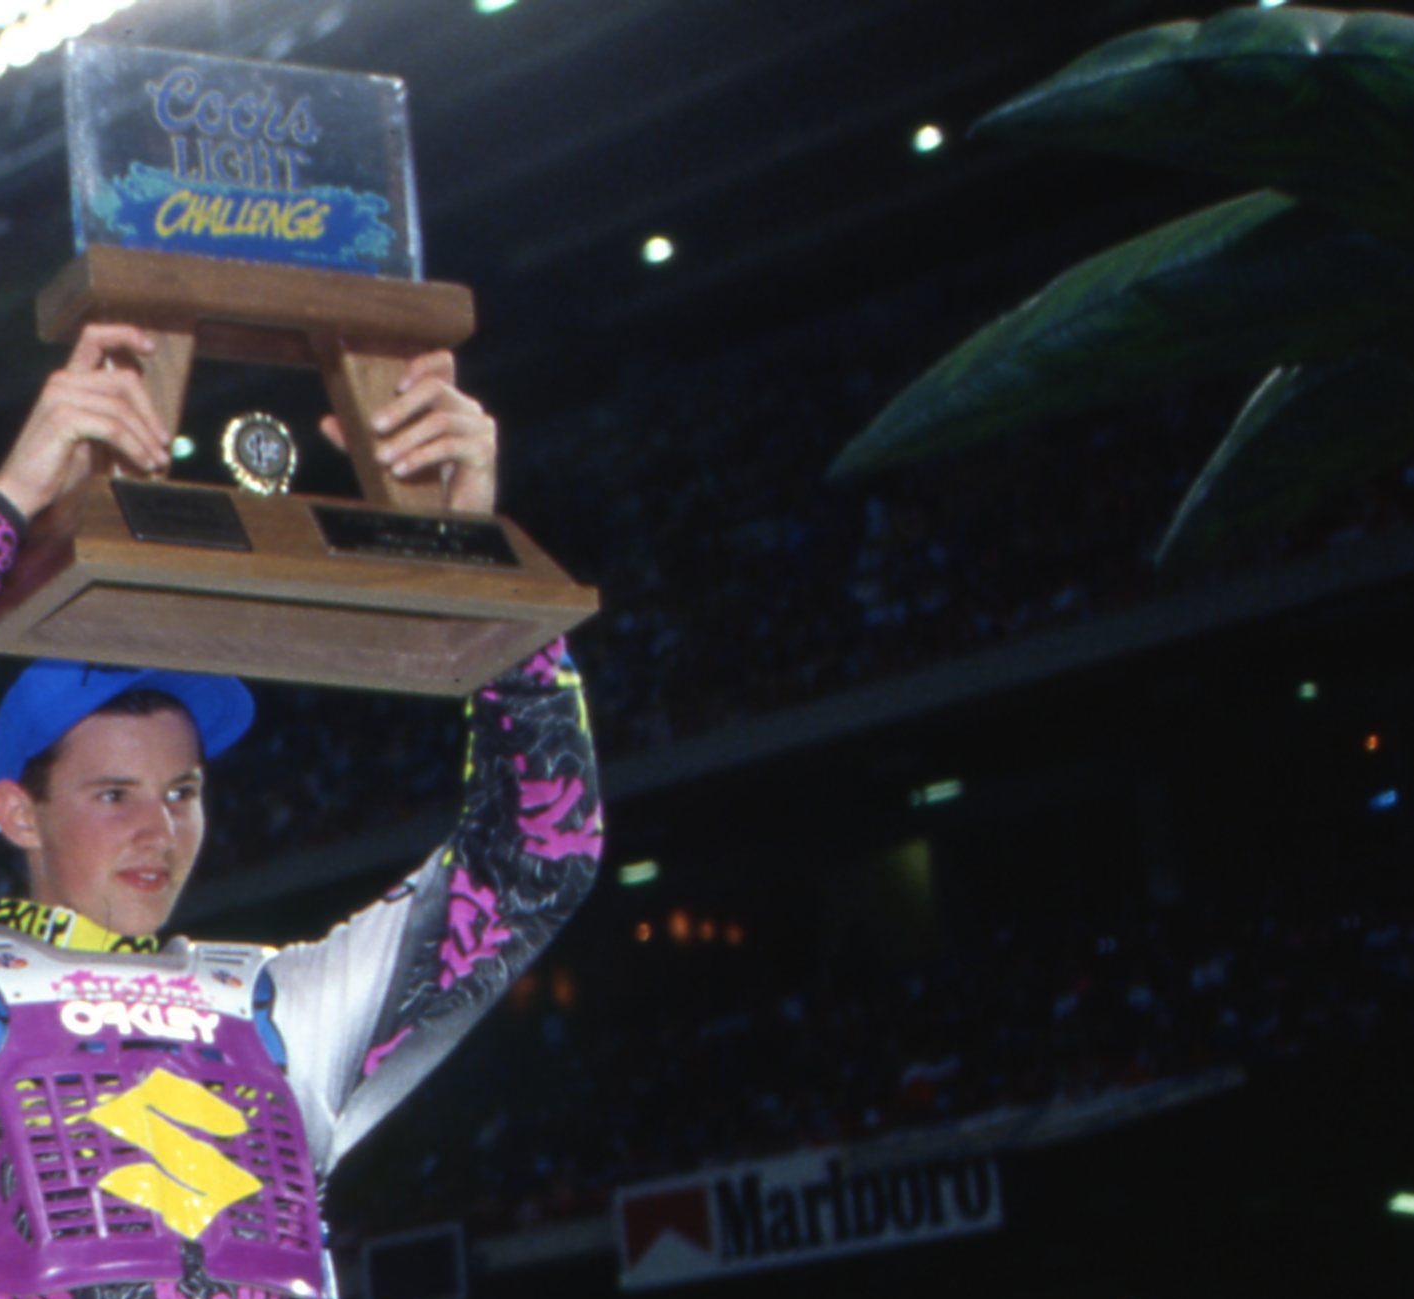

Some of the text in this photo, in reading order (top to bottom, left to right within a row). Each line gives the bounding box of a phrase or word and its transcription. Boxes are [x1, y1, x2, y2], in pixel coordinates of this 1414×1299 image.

[146, 66, 321, 143] Coors
[171, 134, 312, 191] LIGHT
[154, 190, 331, 240] CHALLENGE
[59, 1000, 221, 1044] OAKLEY
[716, 1157, 991, 1260] Marlboro
